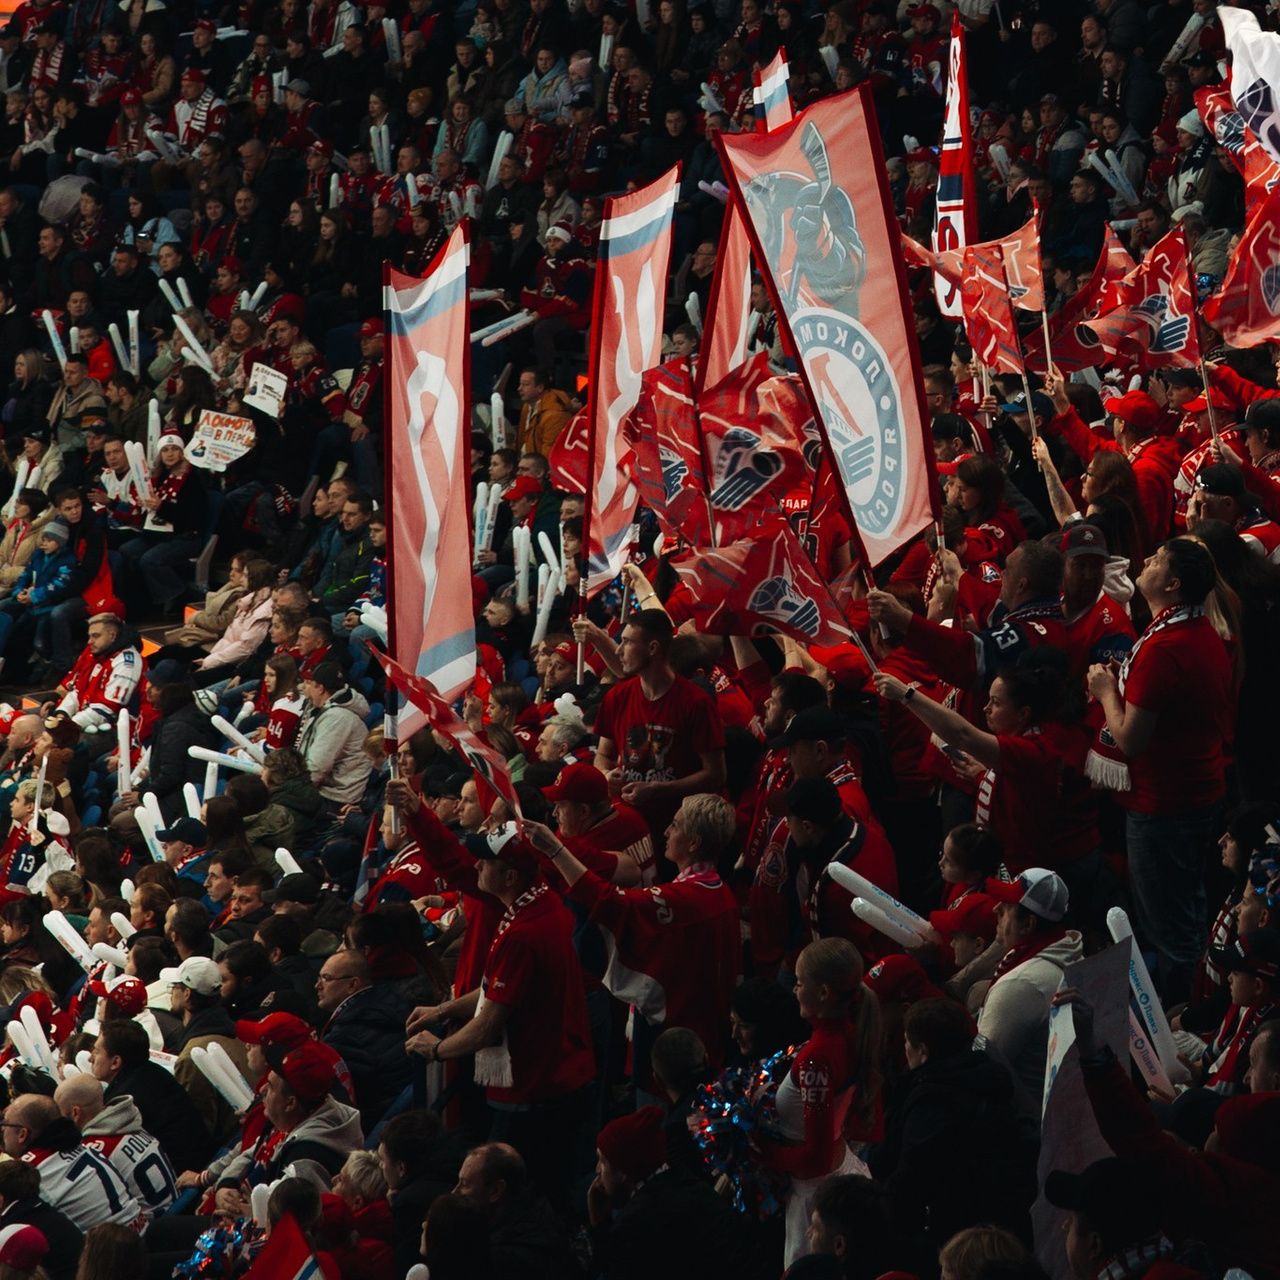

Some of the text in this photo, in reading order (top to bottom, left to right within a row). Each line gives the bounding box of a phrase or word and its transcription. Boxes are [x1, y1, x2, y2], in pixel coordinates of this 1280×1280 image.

[267, 709, 284, 739] 44
[18, 853, 36, 874] 13
[798, 1069, 829, 1087] FON
[800, 1086, 830, 1104] BET
